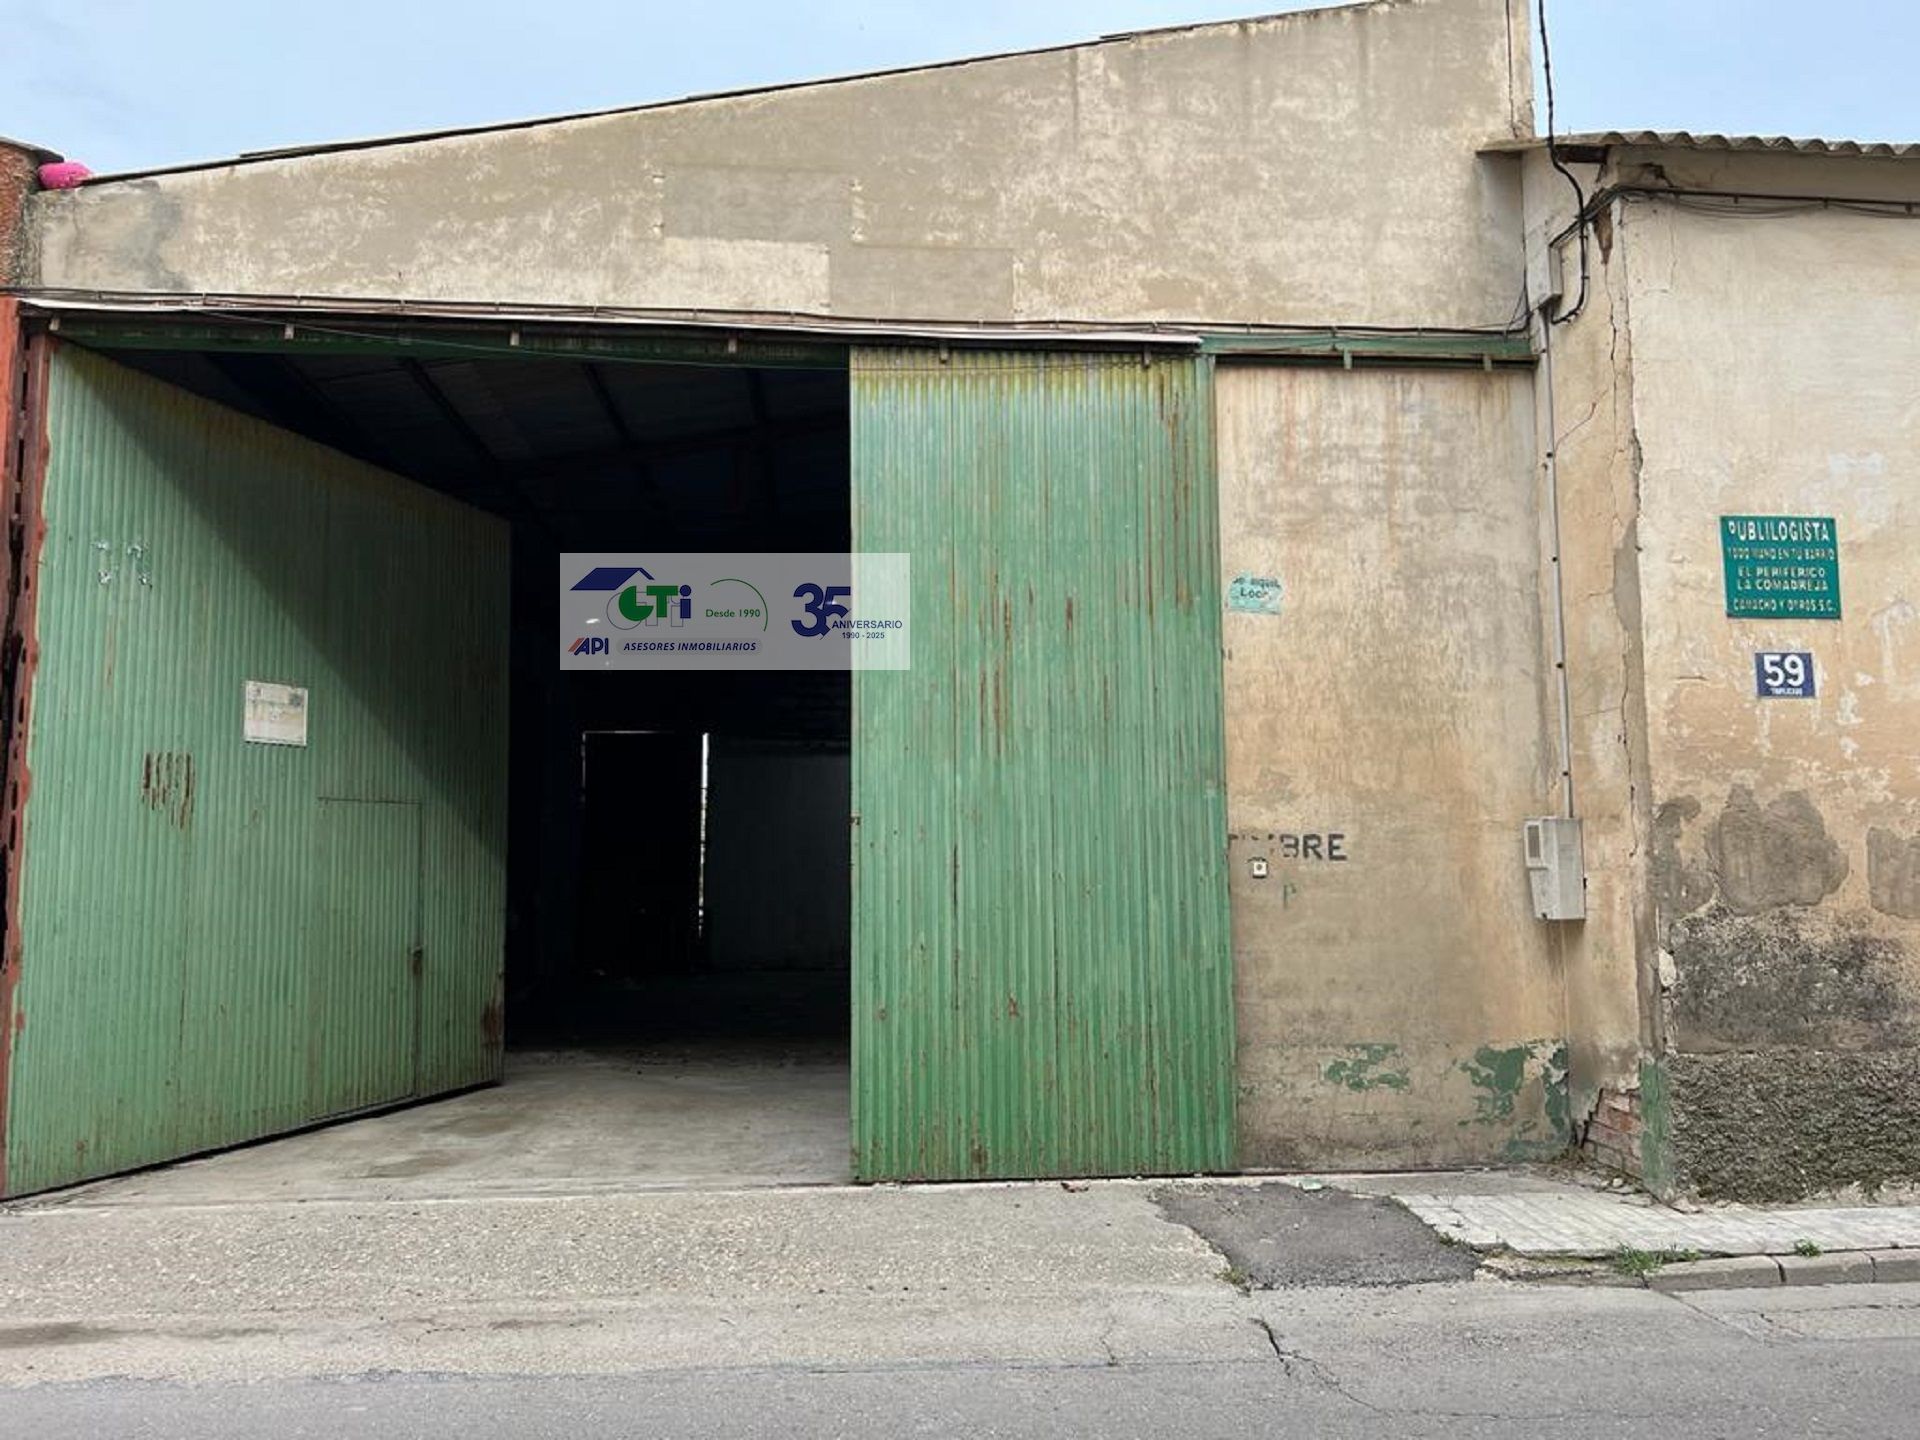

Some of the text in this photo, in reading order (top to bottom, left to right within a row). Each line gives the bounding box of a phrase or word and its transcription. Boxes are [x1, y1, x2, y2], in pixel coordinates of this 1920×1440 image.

[1728, 521, 1829, 541] PUBLILOGISTA
[1738, 566, 1751, 577] EL
[1737, 579, 1828, 591] LA COMADREJA
[1763, 654, 1804, 687] 59
